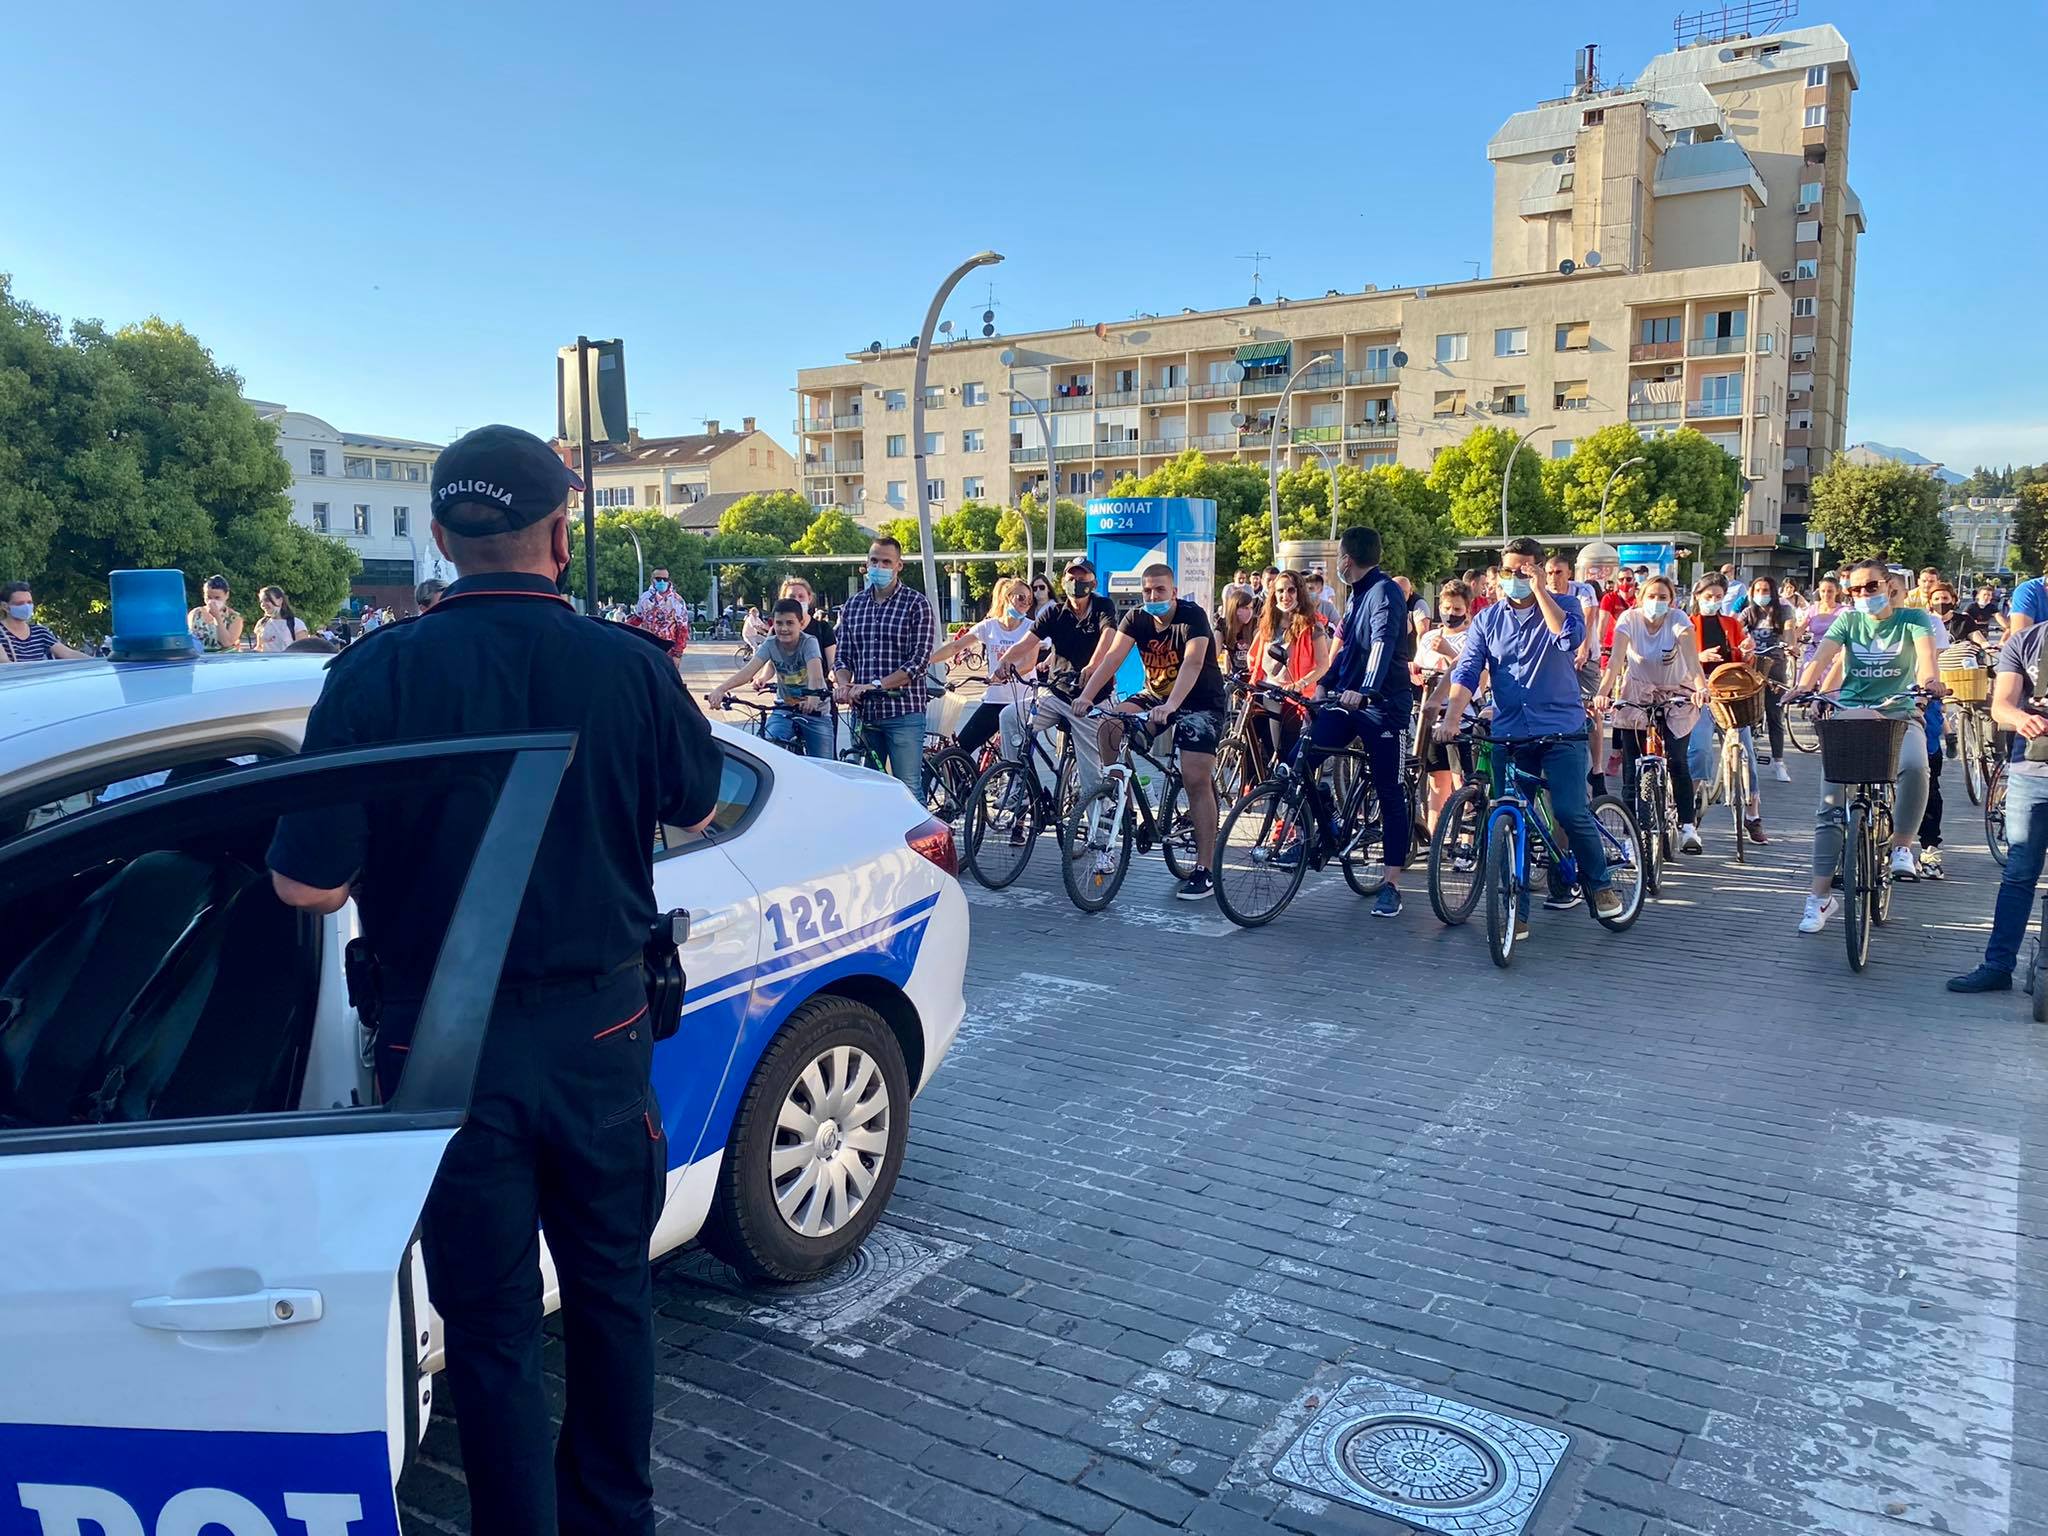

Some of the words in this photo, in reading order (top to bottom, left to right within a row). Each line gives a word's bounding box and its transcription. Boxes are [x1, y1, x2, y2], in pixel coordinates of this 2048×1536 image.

[439, 480, 512, 505] POLICIJA
[1100, 518, 1134, 529] 00-24
[1851, 666, 1902, 678] adidas
[765, 888, 844, 951] 122
